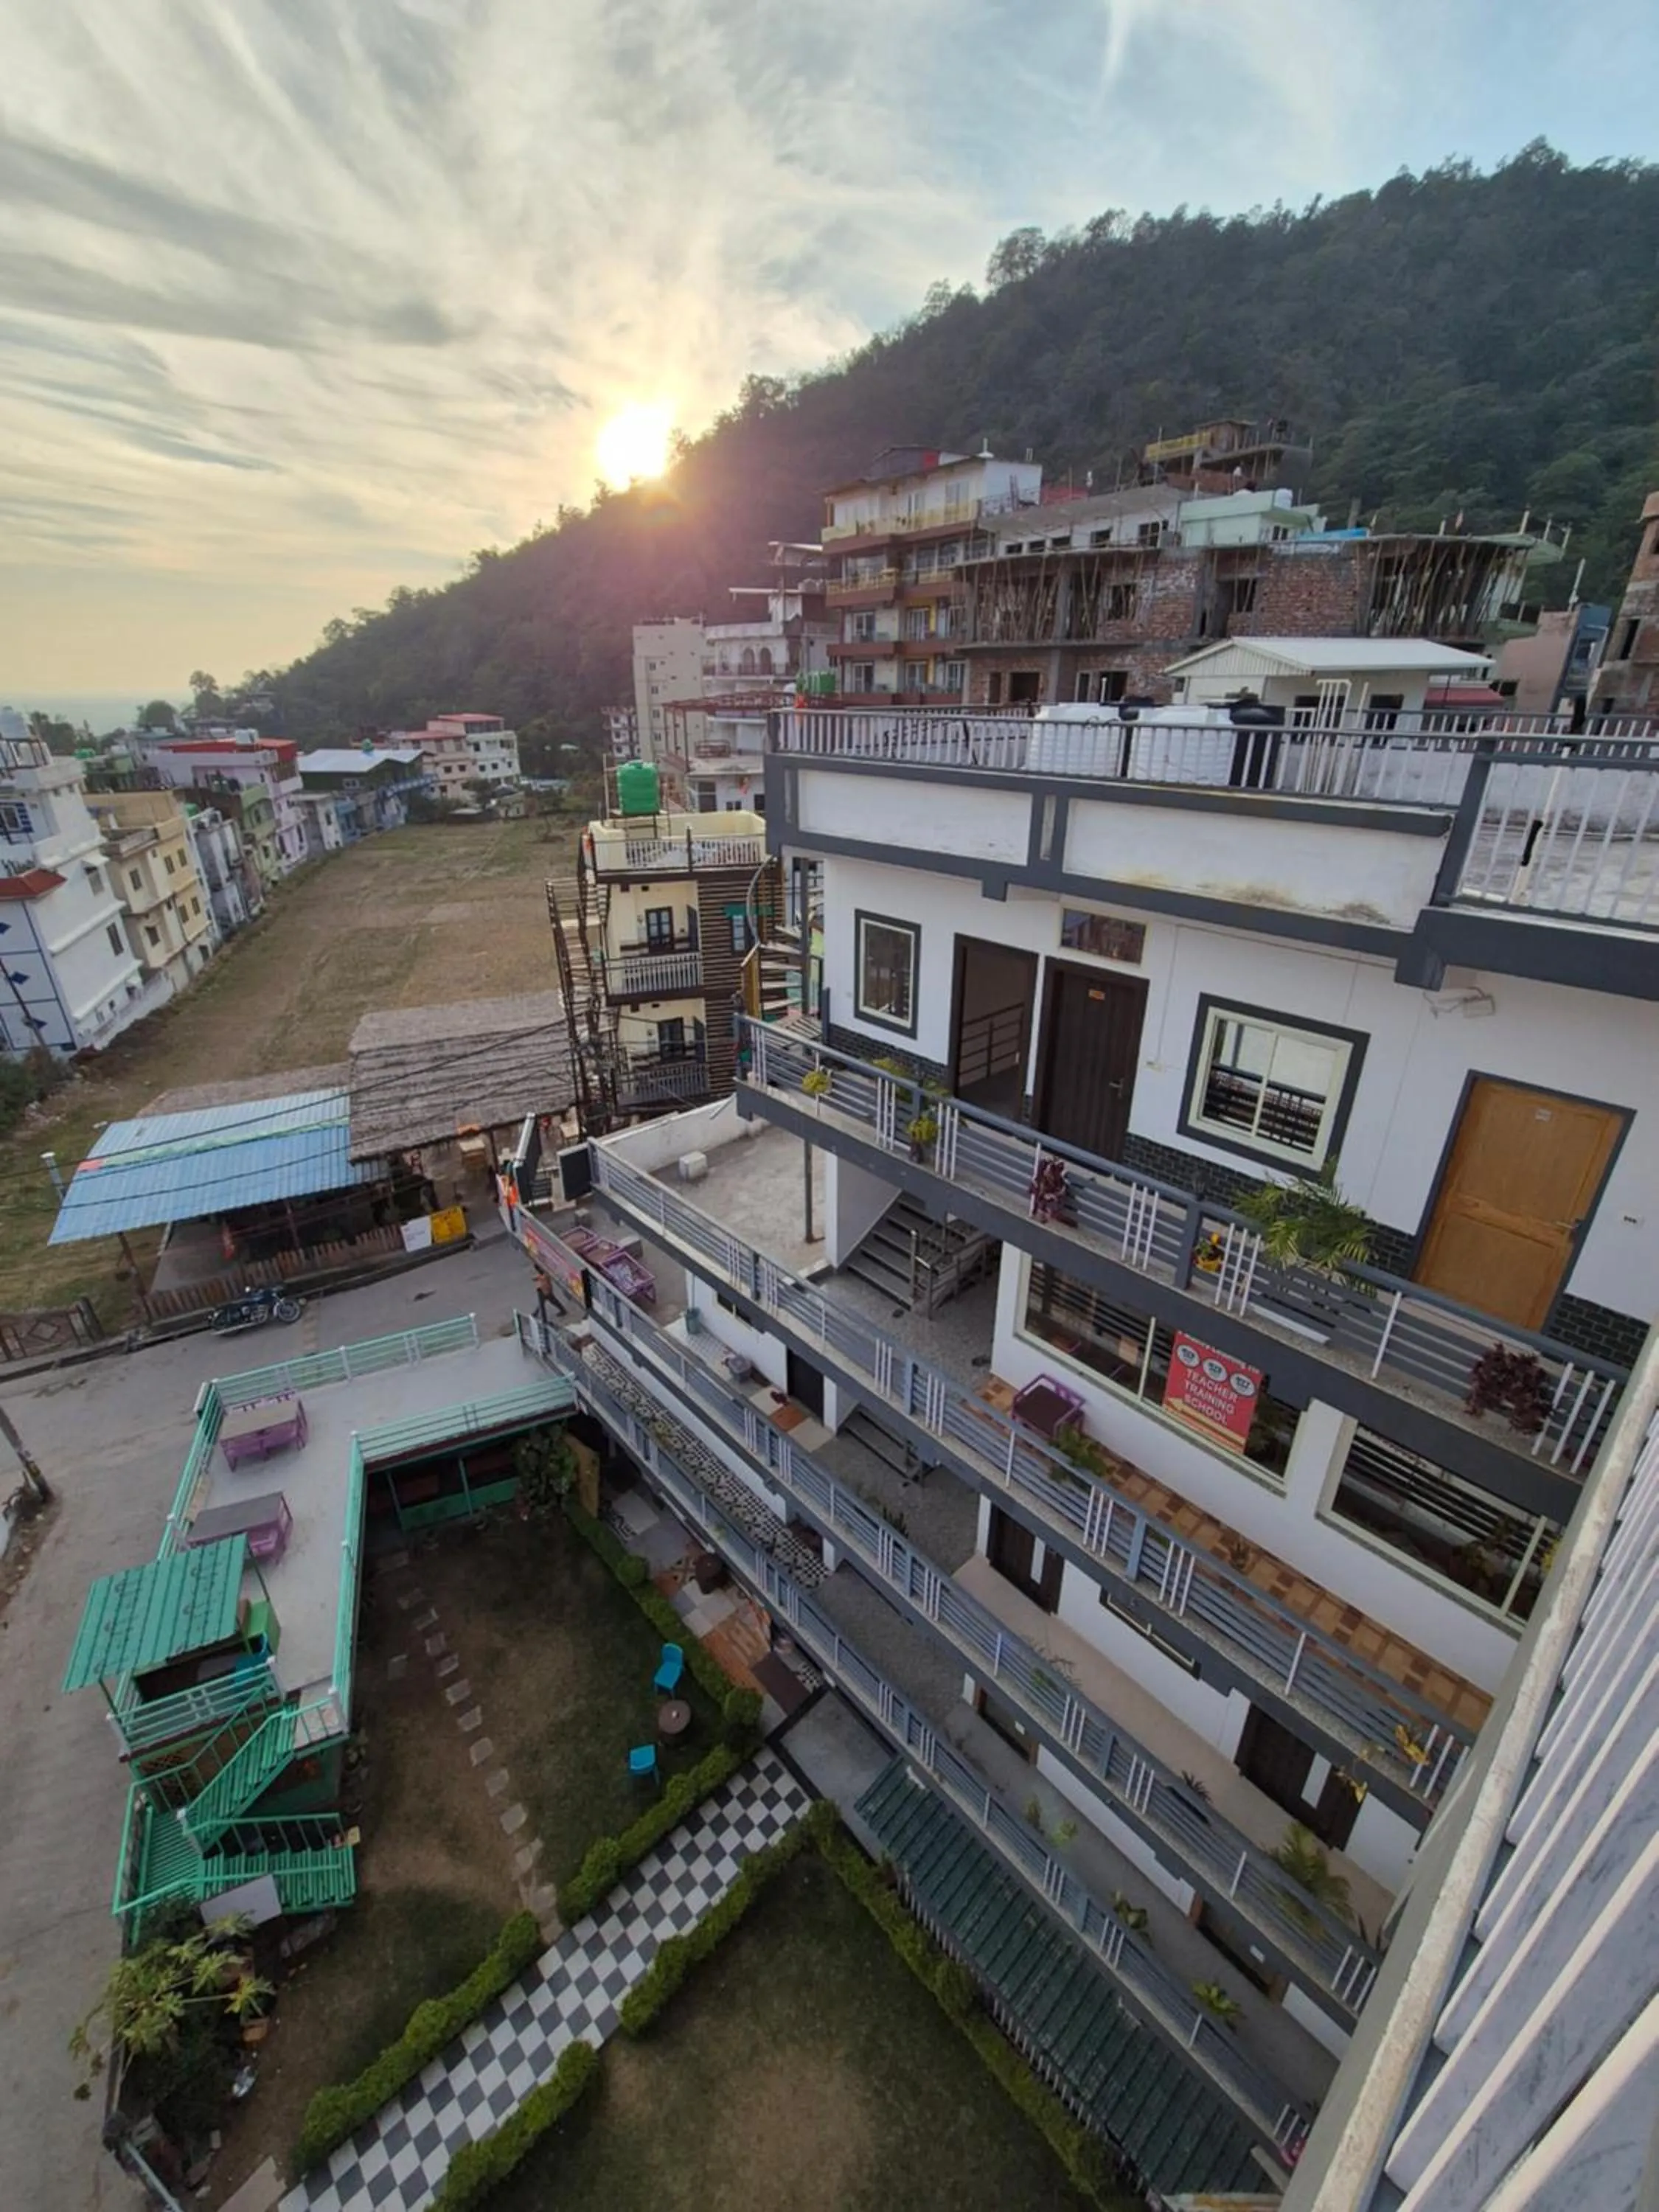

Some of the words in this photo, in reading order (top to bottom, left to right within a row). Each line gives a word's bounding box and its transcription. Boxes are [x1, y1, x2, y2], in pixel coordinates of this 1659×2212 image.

[1184, 1380, 1234, 1415] TRAINING
[1186, 1368, 1237, 1402] TEACHER
[1185, 1394, 1227, 1425] SCHOOL
